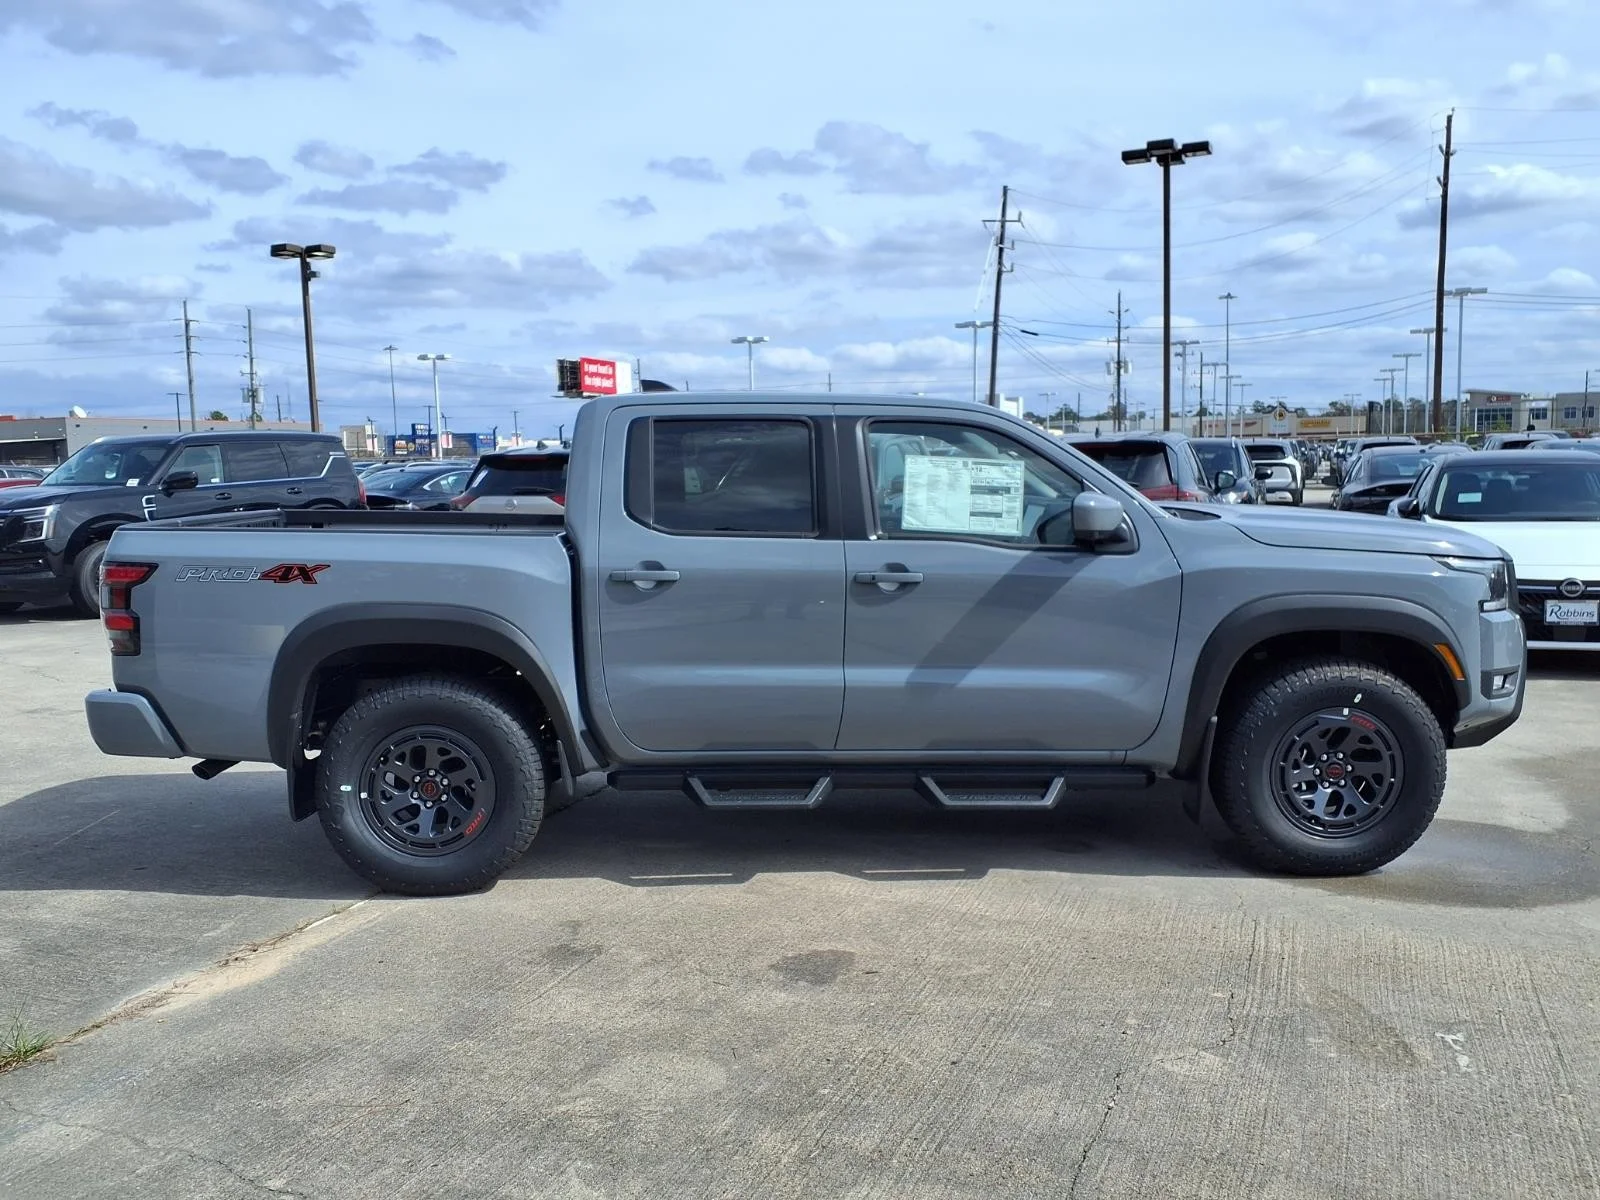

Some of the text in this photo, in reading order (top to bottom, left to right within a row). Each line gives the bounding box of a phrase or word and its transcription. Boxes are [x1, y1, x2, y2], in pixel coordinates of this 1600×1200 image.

[584, 374, 592, 385] the
[592, 375, 602, 388] right
[1549, 604, 1595, 620] Robbins
